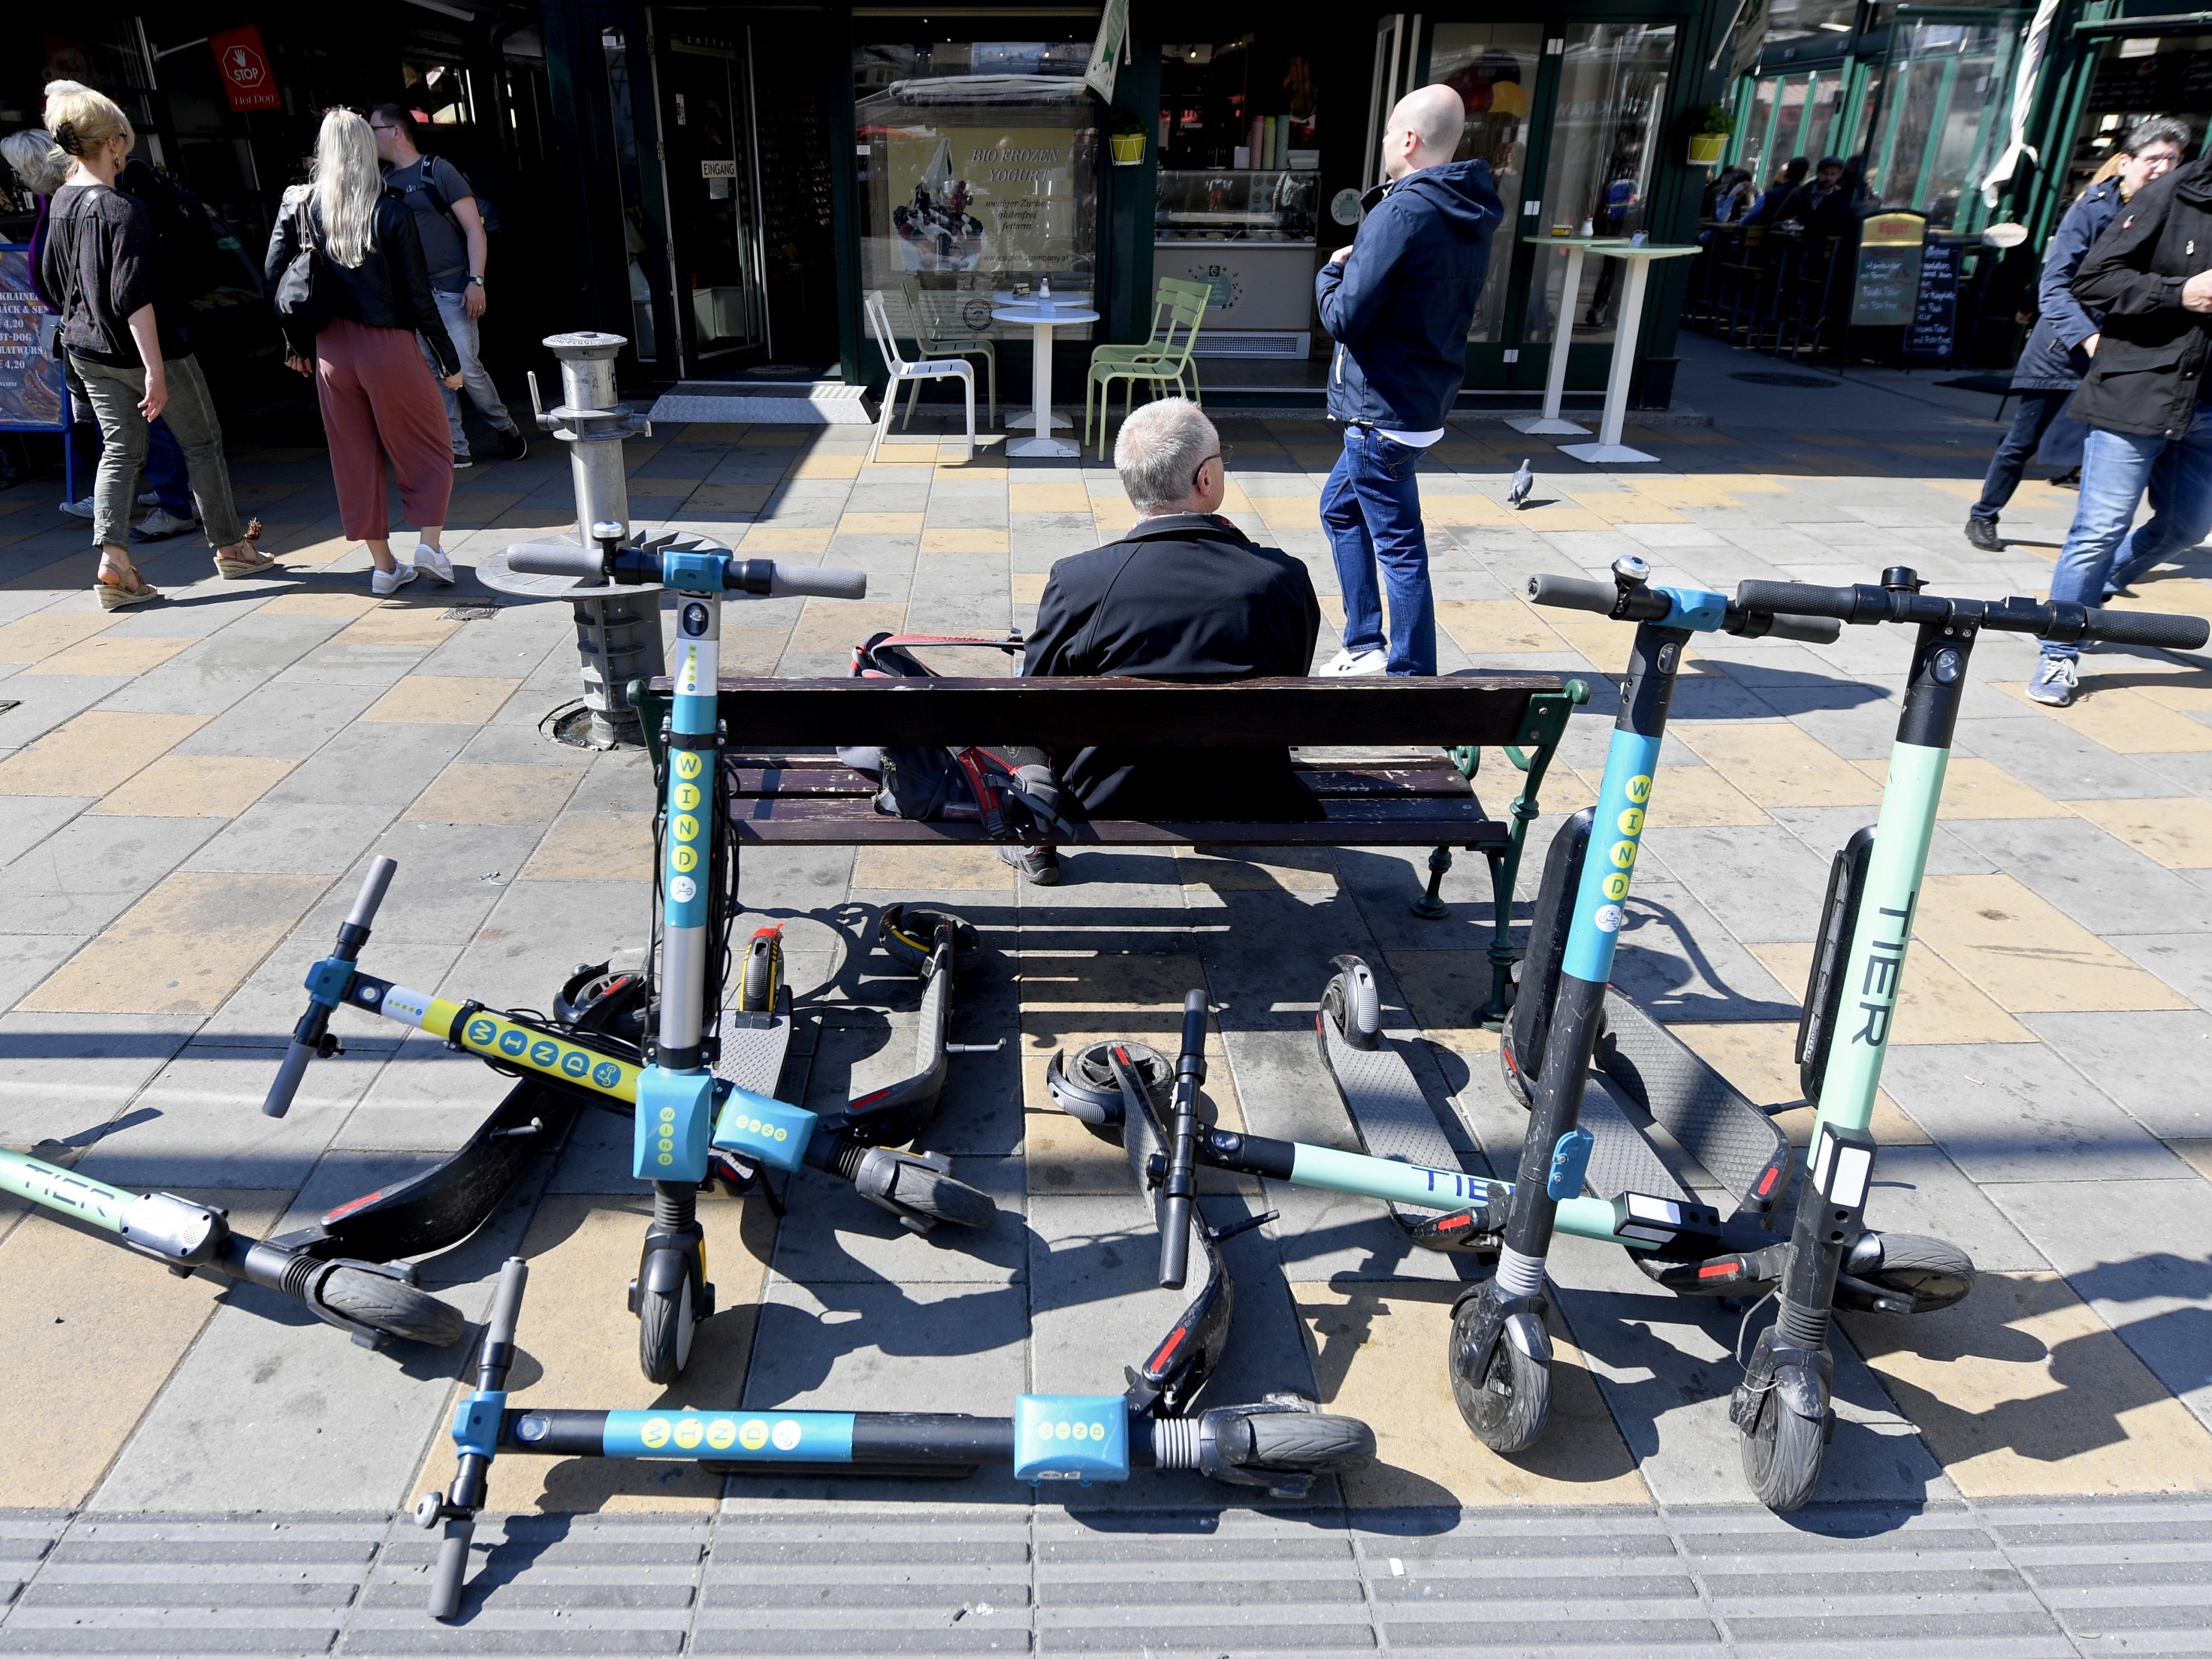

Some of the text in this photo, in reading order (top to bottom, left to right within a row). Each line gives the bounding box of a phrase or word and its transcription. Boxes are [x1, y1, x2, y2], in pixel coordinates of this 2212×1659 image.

[233, 67, 258, 81] STOP
[235, 94, 274, 105] Hot Dog
[972, 149, 1061, 162] BIO FROZEN
[704, 163, 735, 175] EINGANG
[989, 168, 1052, 182] YOGURT
[986, 200, 1019, 209] weniger
[998, 211, 1037, 220] glutenfrei
[1002, 221, 1032, 232] fettarm
[23, 305, 30, 313] &
[4, 319, 24, 328] 4,20
[5, 360, 25, 370] 4,20
[676, 756, 699, 869] WIND
[1607, 778, 1650, 897] WIND
[1852, 891, 1915, 1047] TIER
[470, 1021, 587, 1075] WIND
[738, 1116, 785, 1139] WIND
[660, 1109, 674, 1164] WIND
[1411, 1166, 1516, 1202] TIE
[645, 1420, 764, 1445] WIND
[1041, 1424, 1103, 1438] WIND
